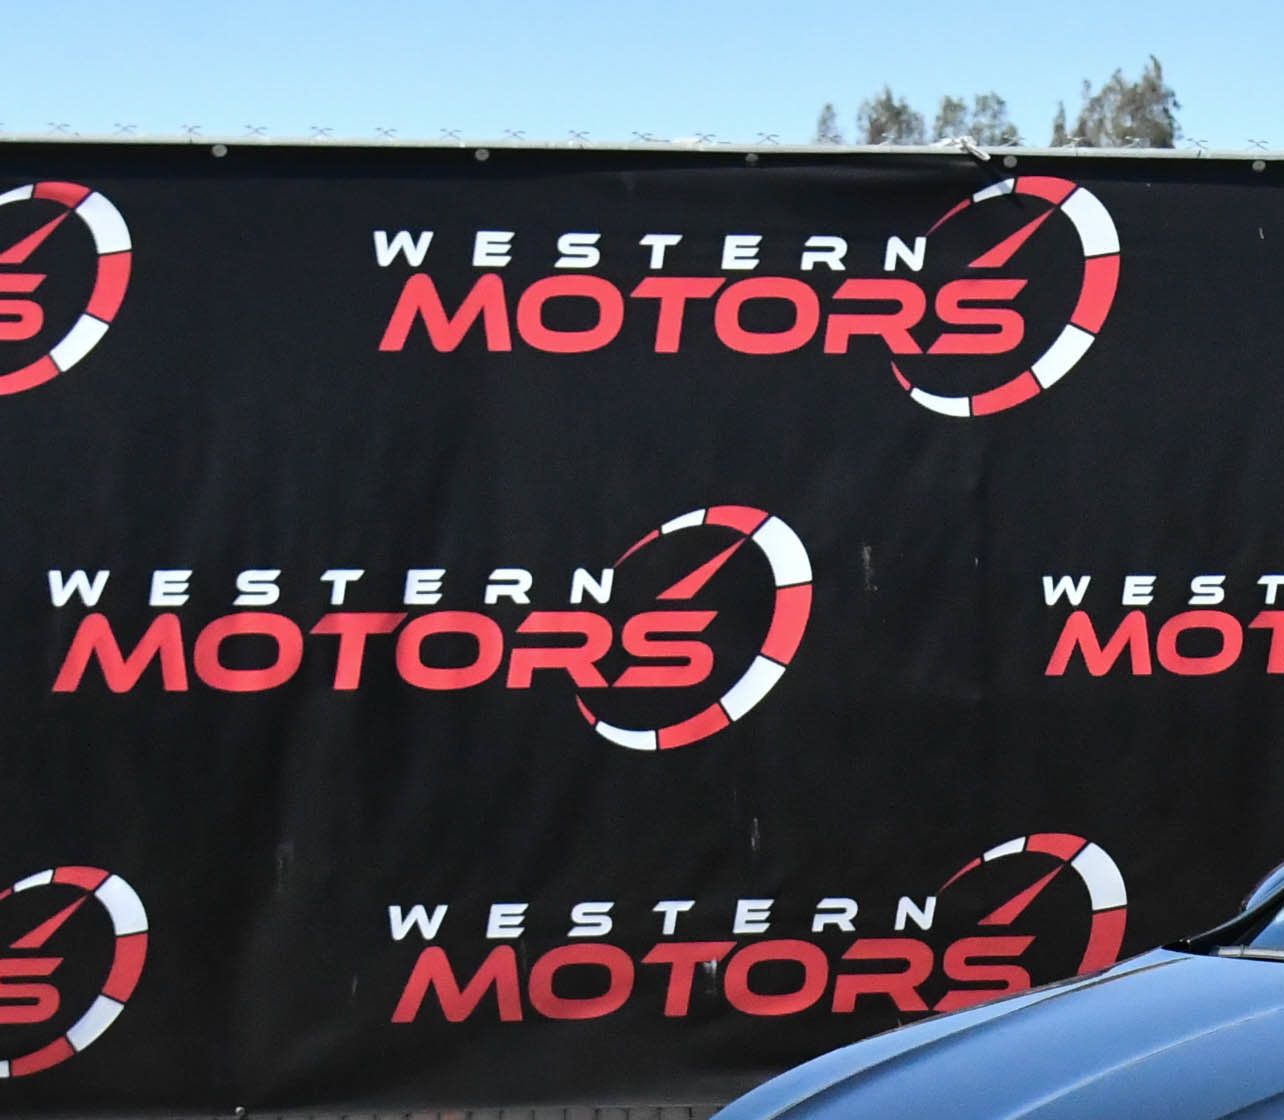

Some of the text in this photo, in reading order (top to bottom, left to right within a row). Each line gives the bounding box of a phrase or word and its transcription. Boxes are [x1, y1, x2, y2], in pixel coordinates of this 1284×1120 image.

[373, 230, 927, 272] WESTERN
[378, 273, 1029, 355] MOTORS
[48, 567, 614, 607] WESTERN
[52, 610, 718, 693] MOTORS
[389, 896, 937, 941] WESTERN
[391, 935, 1037, 1023] MOTORS
